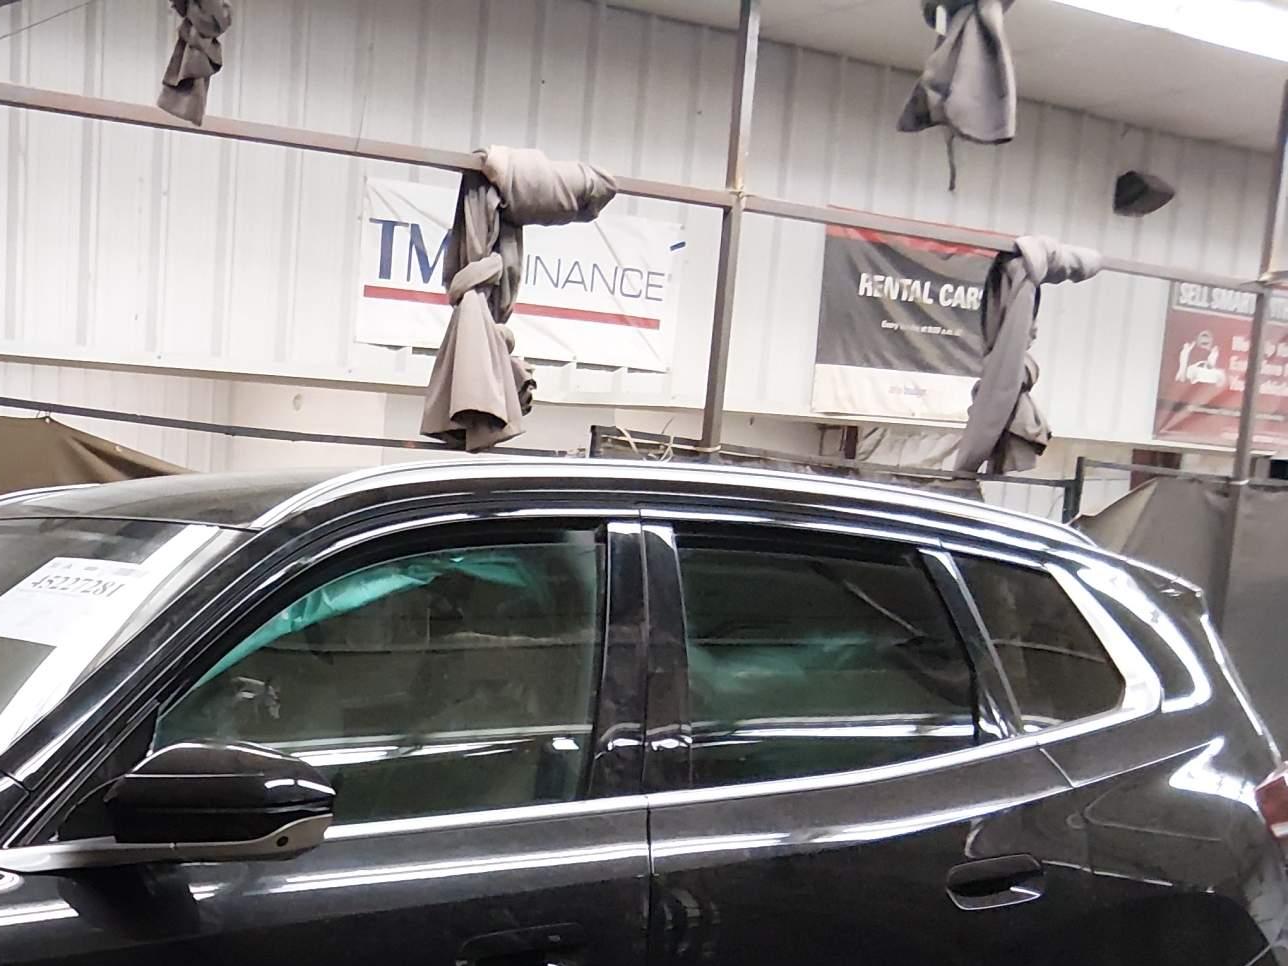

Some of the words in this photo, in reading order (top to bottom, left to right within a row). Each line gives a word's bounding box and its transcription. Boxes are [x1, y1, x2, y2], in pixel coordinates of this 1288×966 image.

[524, 254, 666, 302] INANCE
[858, 272, 934, 305] RENTAL
[31, 575, 126, 598] 45227281
